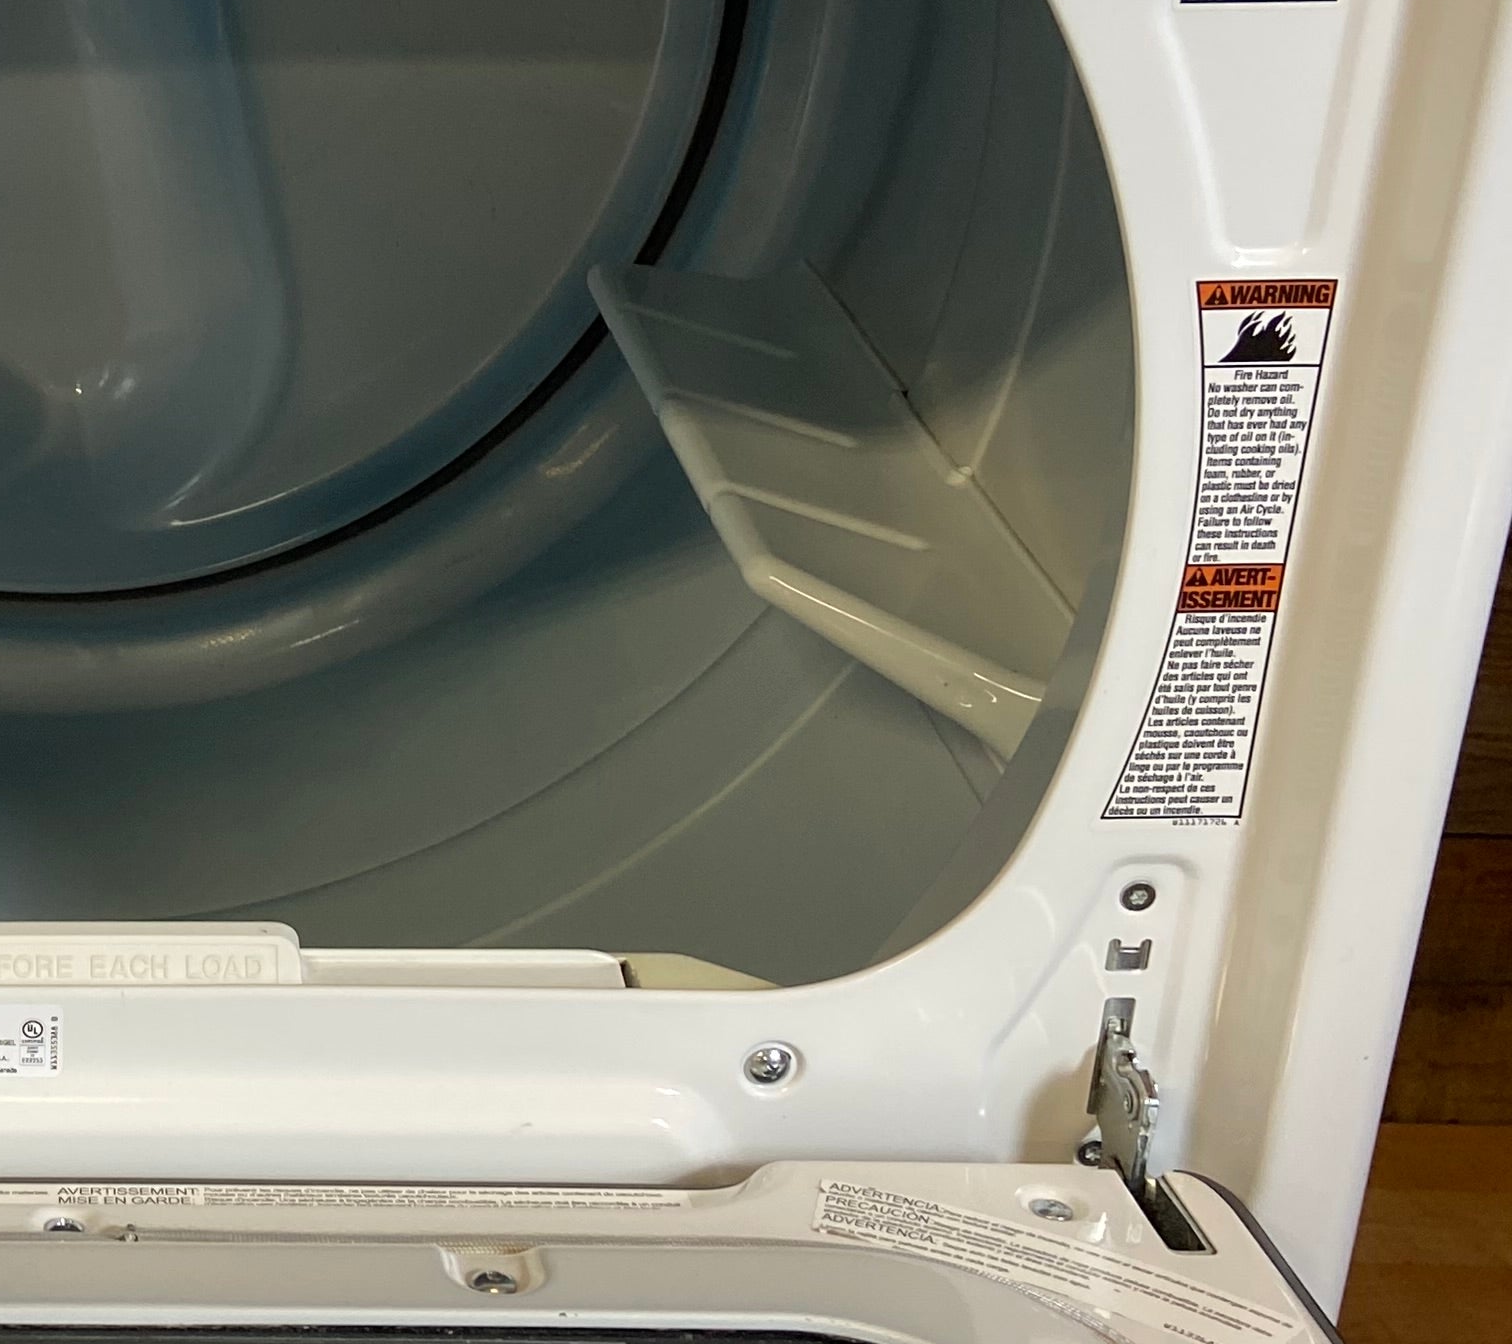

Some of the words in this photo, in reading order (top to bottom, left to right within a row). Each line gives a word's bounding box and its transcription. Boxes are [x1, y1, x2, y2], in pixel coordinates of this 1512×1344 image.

[1231, 285, 1330, 304] WARNING
[1235, 371, 1253, 380] Fire
[1255, 370, 1288, 380] Hazard
[1208, 383, 1221, 393] No
[1223, 383, 1258, 393] washer
[1261, 384, 1277, 392] can
[1280, 383, 1304, 392] com-
[1208, 395, 1240, 407] pletely
[1242, 396, 1277, 405] remove
[1280, 395, 1295, 405] oil.
[1207, 408, 1220, 418] Do
[1223, 408, 1237, 417] not
[1240, 408, 1254, 419] dry
[1257, 408, 1298, 419] anything
[1207, 421, 1225, 430] that
[1228, 421, 1244, 430] has
[1247, 421, 1267, 429] ever
[1270, 420, 1287, 429] had
[1290, 421, 1306, 431] any
[1207, 433, 1227, 444] type
[1230, 433, 1239, 442] of
[1241, 433, 1252, 442] oil
[1255, 434, 1267, 442] on
[1206, 445, 1239, 456] cluding
[1241, 445, 1276, 456] cooking
[1279, 444, 1302, 455] oils).
[1206, 457, 1232, 467] Items
[1235, 457, 1281, 468] containing
[1204, 469, 1228, 479] foam,
[1232, 469, 1262, 479] rubber,
[1266, 470, 1275, 478] or
[1202, 481, 1231, 493] plastic
[1234, 481, 1256, 490] must
[1259, 481, 1270, 490] be
[1272, 481, 1295, 490] dried
[1200, 494, 1211, 502] on
[1271, 493, 1279, 502] or
[1282, 493, 1292, 504] by
[1199, 505, 1224, 516] using
[1226, 506, 1238, 515] an
[1240, 505, 1254, 515] Air
[1257, 505, 1283, 516] Cycle.
[1198, 517, 1230, 527] Failure
[1233, 517, 1241, 527] to
[1244, 517, 1272, 526] follow
[1197, 529, 1222, 539] these
[1225, 529, 1277, 538] instructions
[1195, 541, 1211, 550] can
[1214, 541, 1239, 550] result
[1241, 541, 1249, 550] in
[1252, 541, 1276, 550] death
[1192, 554, 1201, 562] or
[1203, 553, 1220, 562] fire.
[1211, 568, 1276, 586] AVERT-
[1181, 591, 1277, 608] ISSEMENT
[1185, 614, 1216, 626] Risque
[90, 954, 167, 978] EACH
[185, 954, 262, 978] LOAD
